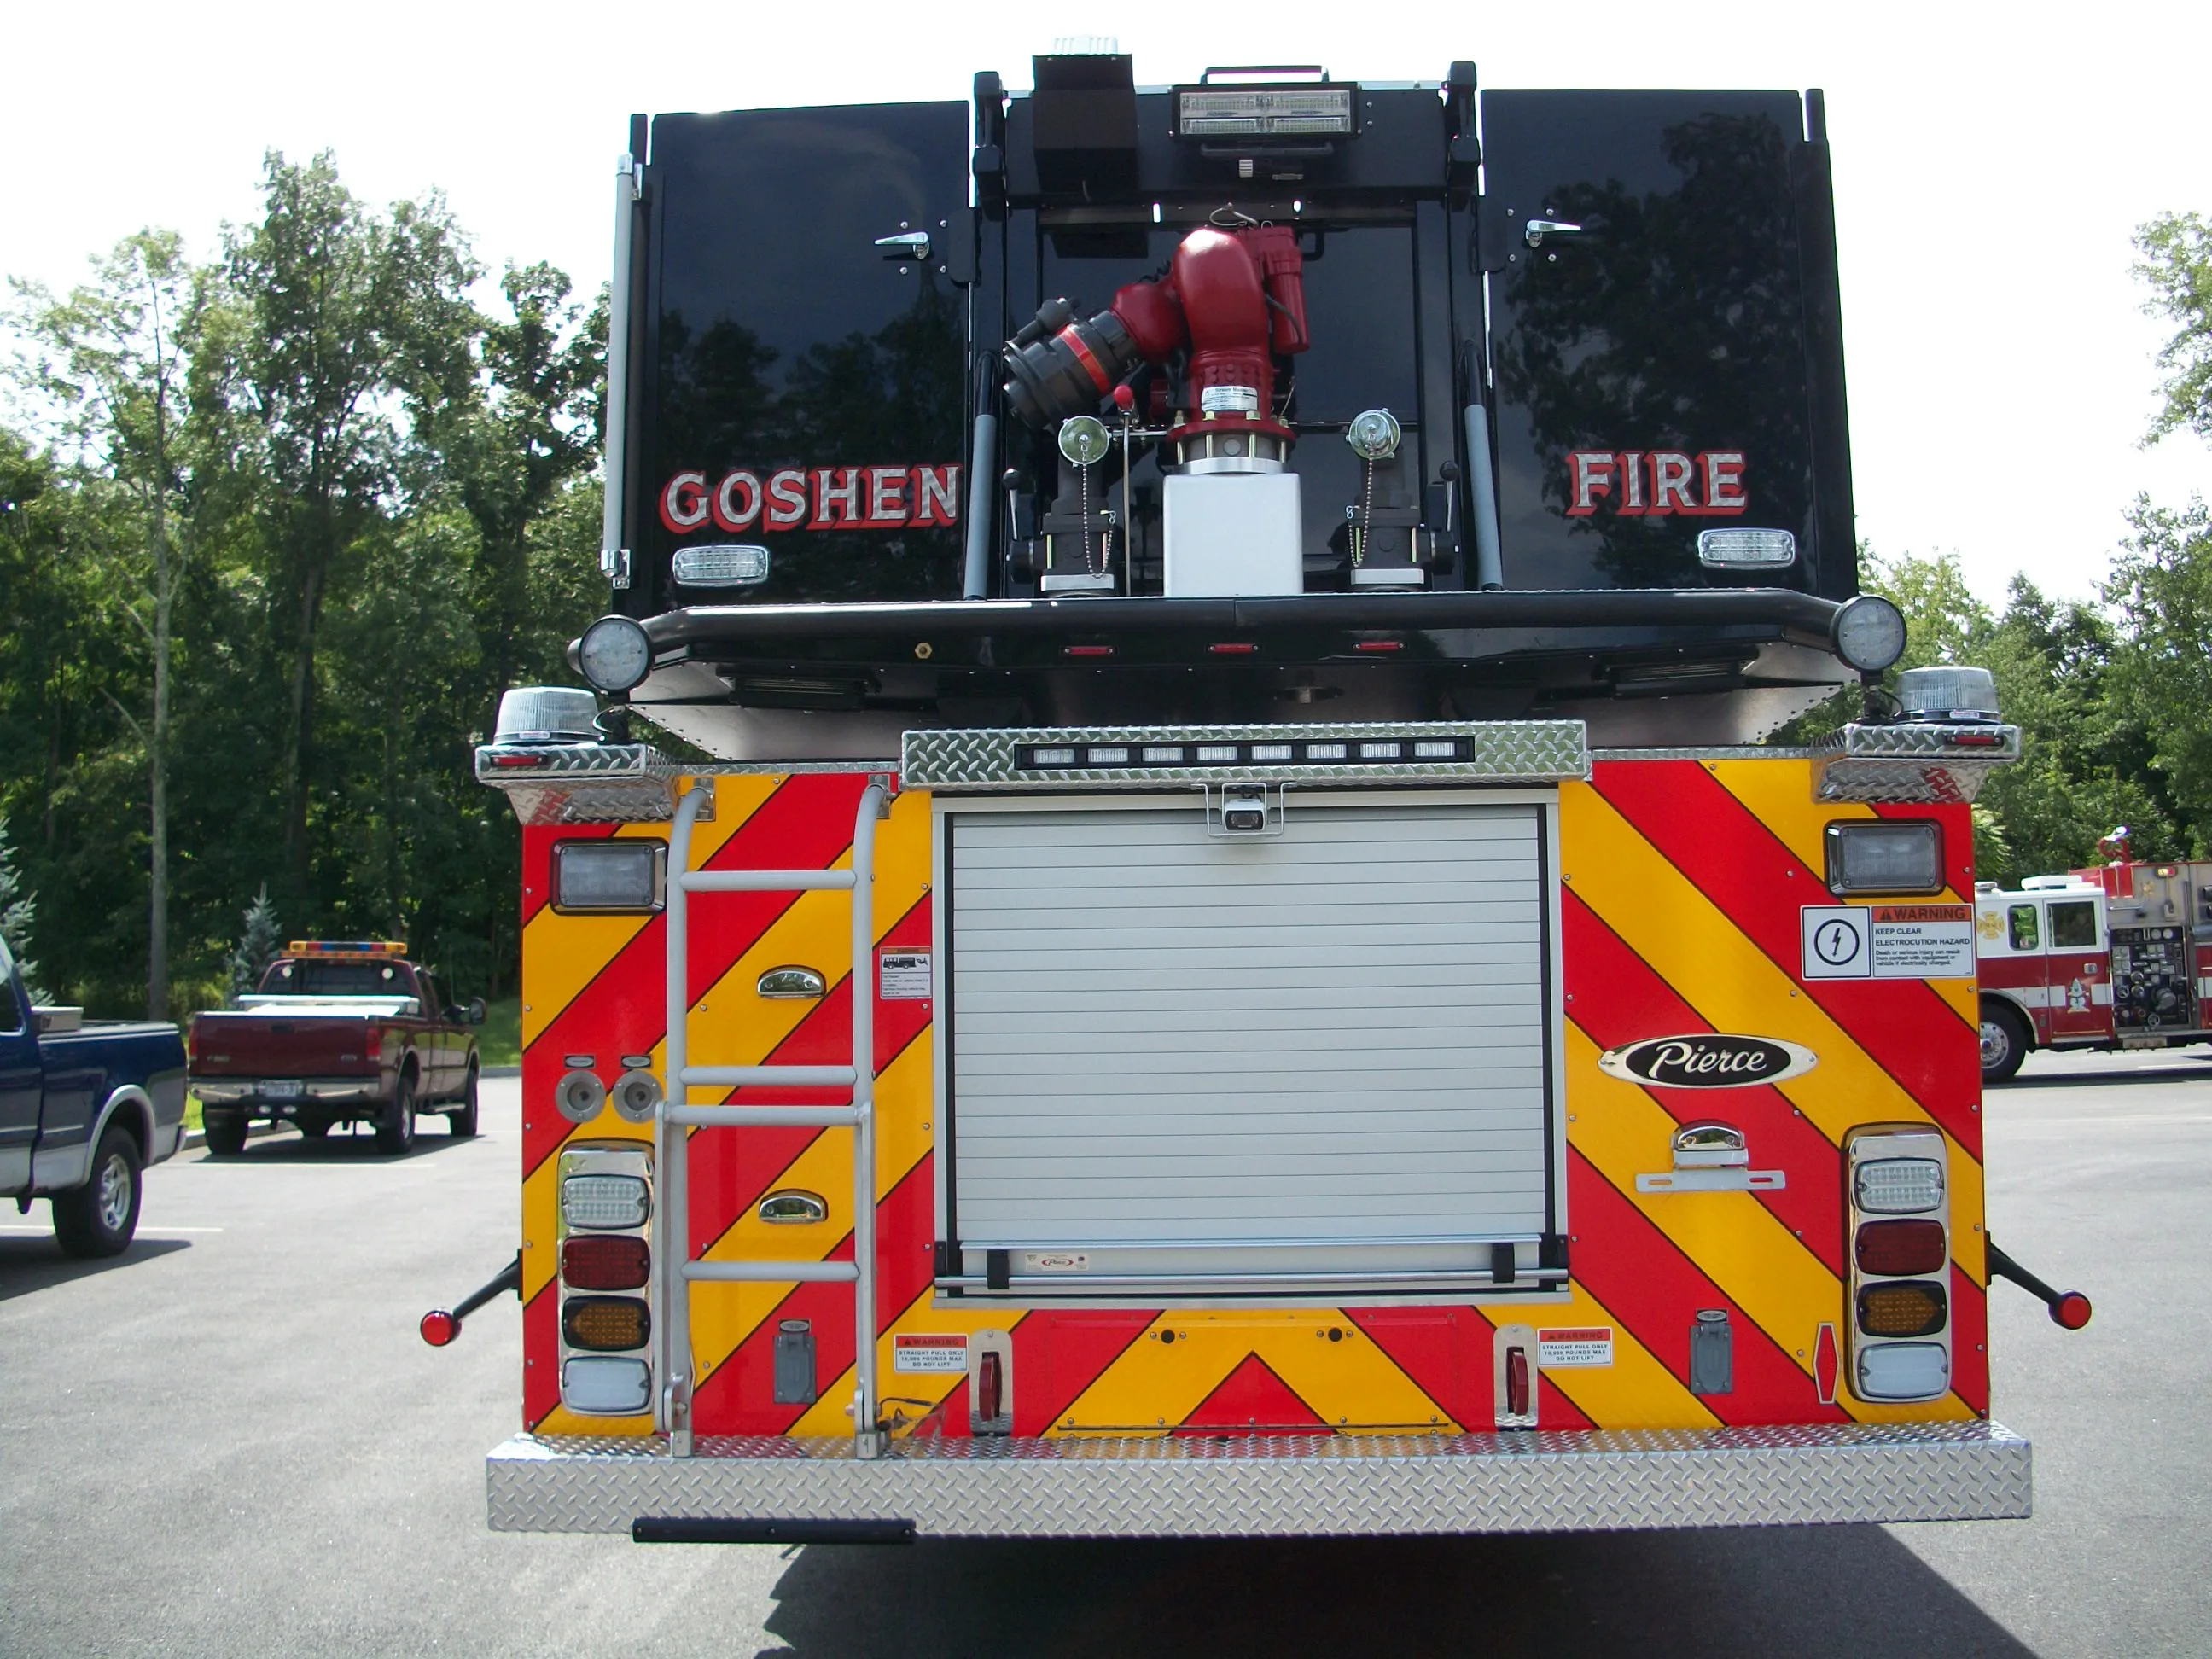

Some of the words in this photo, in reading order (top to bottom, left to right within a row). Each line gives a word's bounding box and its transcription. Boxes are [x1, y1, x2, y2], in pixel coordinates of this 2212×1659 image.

[660, 463, 962, 533] GOSHEN
[1565, 451, 1748, 515] FIRE
[1894, 908, 1965, 920] WARNING
[1648, 1041, 1767, 1080] Pierce
[914, 1337, 958, 1346] WARNING
